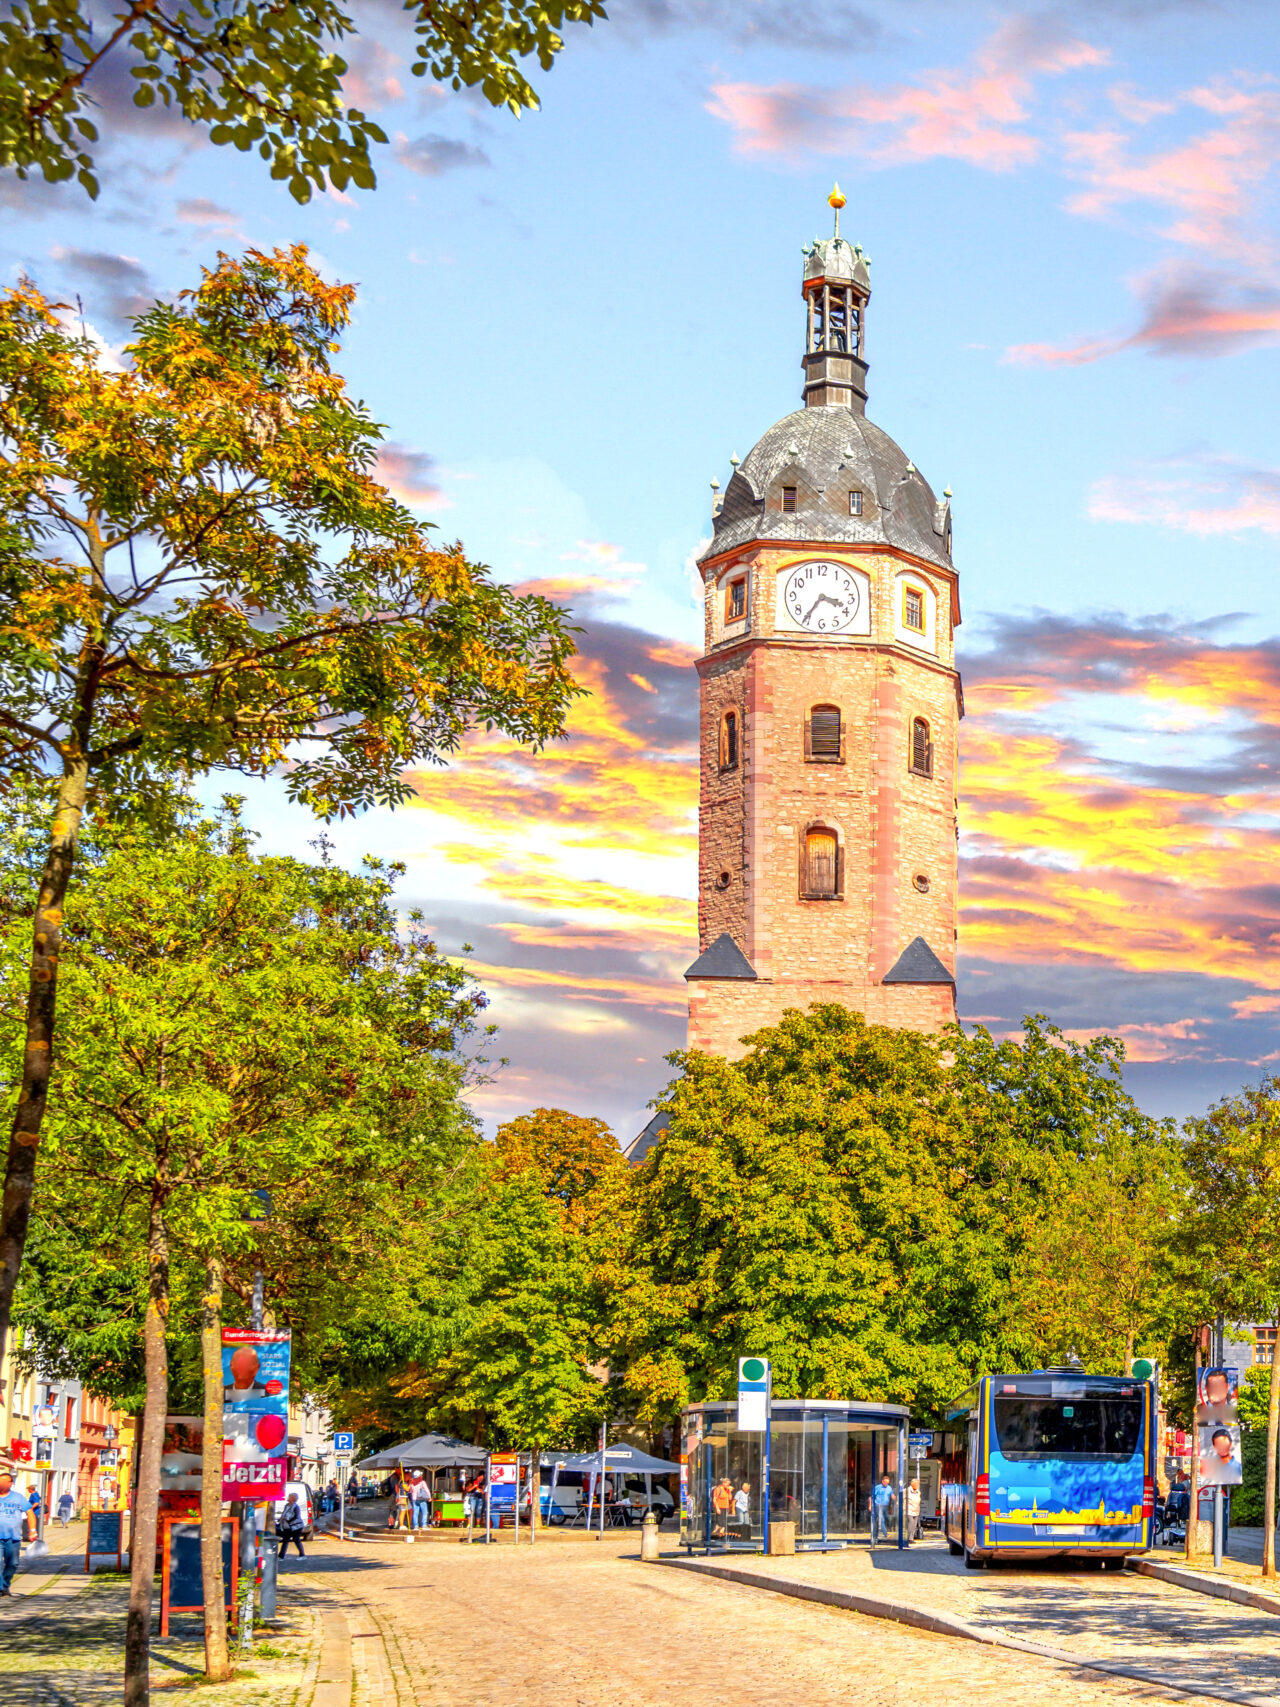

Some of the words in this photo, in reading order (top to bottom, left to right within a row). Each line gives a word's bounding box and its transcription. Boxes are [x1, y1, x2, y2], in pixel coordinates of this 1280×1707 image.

[805, 568, 812, 579] 11
[817, 565, 828, 576] 12
[794, 577, 805, 588] 10
[843, 579, 850, 590] 2
[789, 590, 797, 602] 9
[847, 593, 855, 605] 3
[795, 604, 802, 615] 8
[842, 606, 850, 617] 4
[818, 619, 826, 630] 6
[831, 615, 840, 627] 5
[338, 1435, 349, 1448] P
[223, 1463, 282, 1483] Jetzt!
